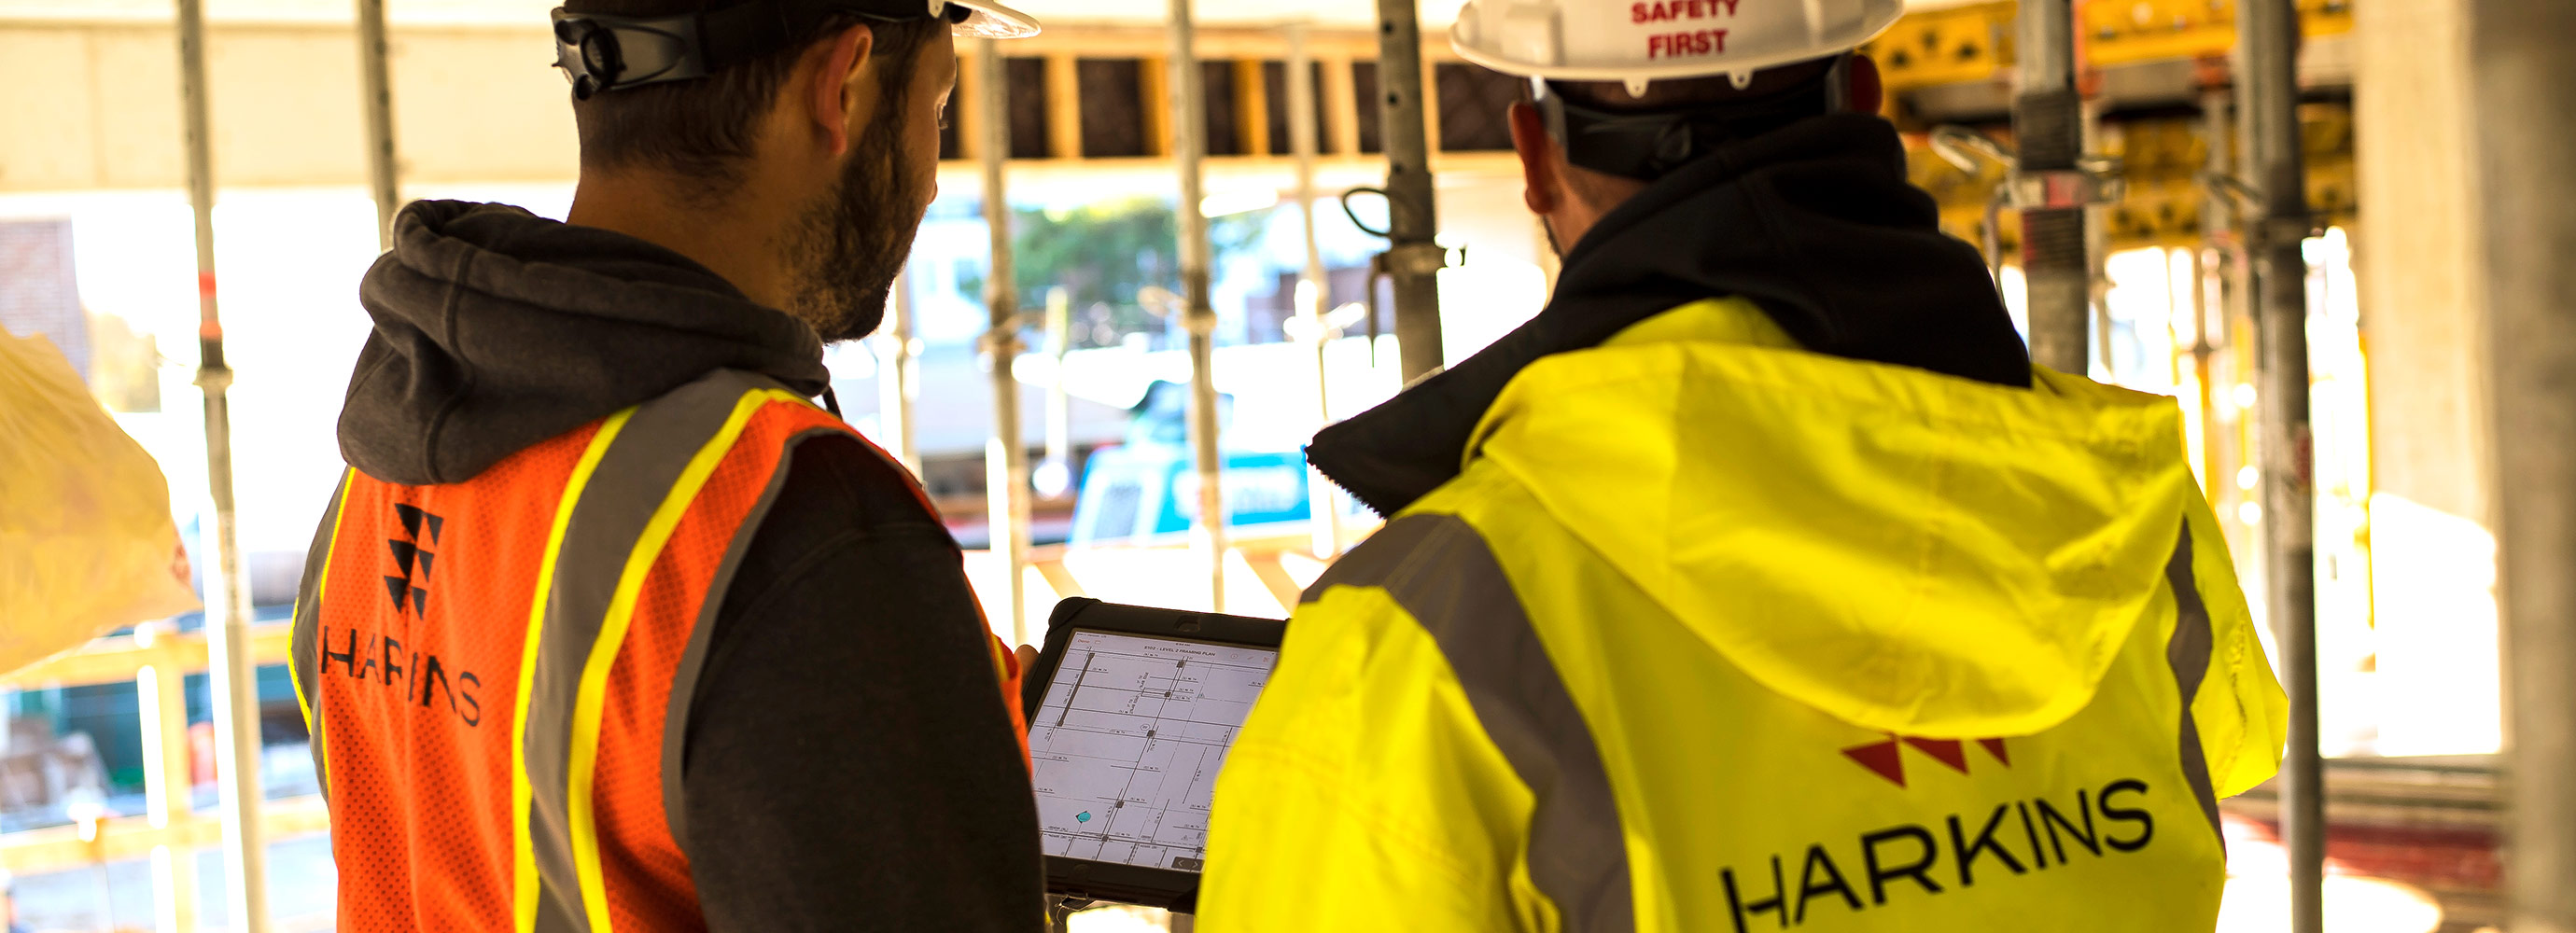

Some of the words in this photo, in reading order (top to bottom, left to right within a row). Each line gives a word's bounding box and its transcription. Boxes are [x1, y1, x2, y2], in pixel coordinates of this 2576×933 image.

[1631, 0, 1740, 24] SAFETY
[1648, 28, 1729, 60] FIRST
[1719, 777, 2155, 933] HARKINS
